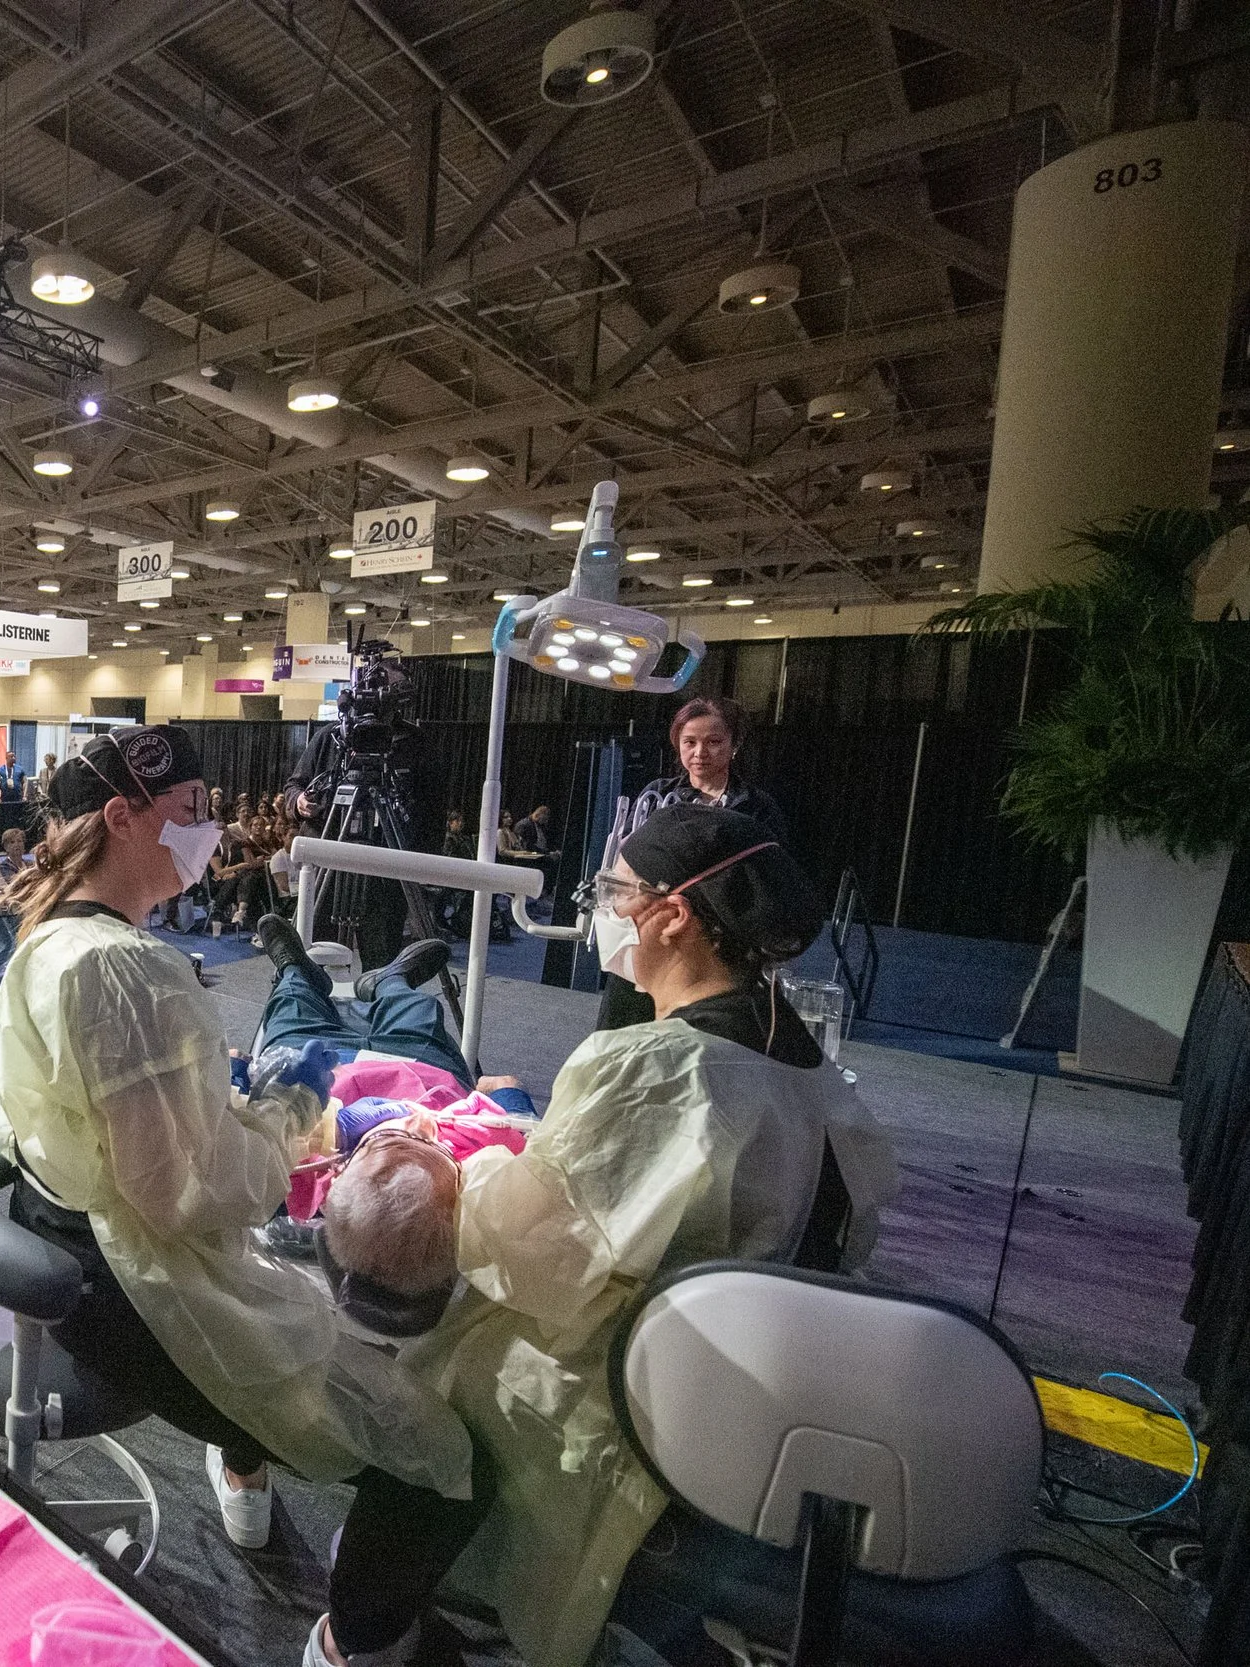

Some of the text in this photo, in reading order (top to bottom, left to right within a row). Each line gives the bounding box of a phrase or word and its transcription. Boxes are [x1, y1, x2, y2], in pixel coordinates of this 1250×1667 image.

[1094, 158, 1162, 193] 803
[368, 516, 418, 544] 200
[129, 553, 162, 575] 300
[129, 737, 159, 757] GUIDED
[141, 755, 170, 774] THERAPY
